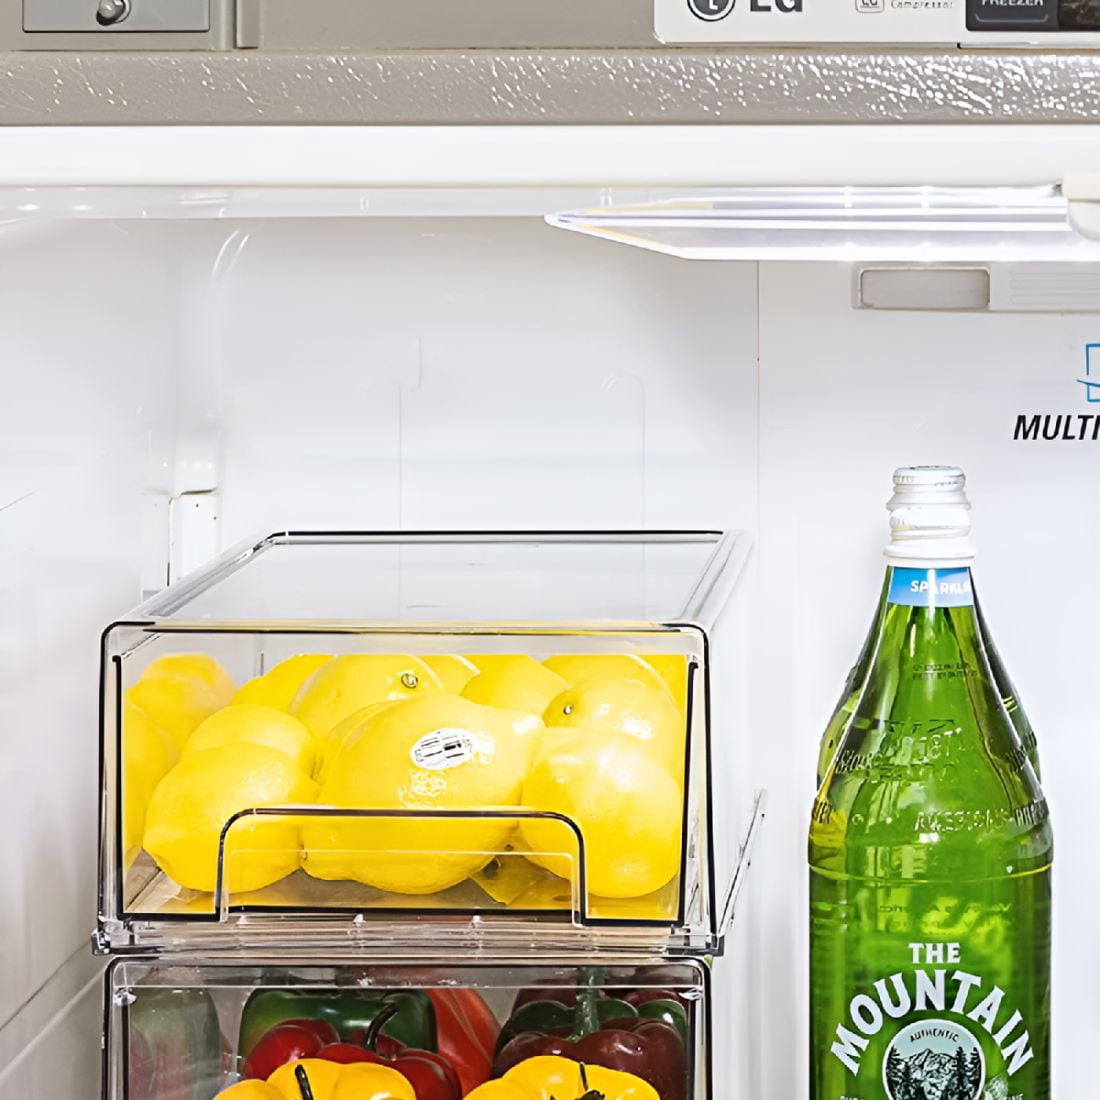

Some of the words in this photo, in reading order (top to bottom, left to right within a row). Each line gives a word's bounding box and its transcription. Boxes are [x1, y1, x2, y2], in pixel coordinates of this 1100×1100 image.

[908, 942, 961, 964] THE
[830, 969, 1034, 1077] MOUNTAIN
[910, 1027, 959, 1043] AUTHENTIC
